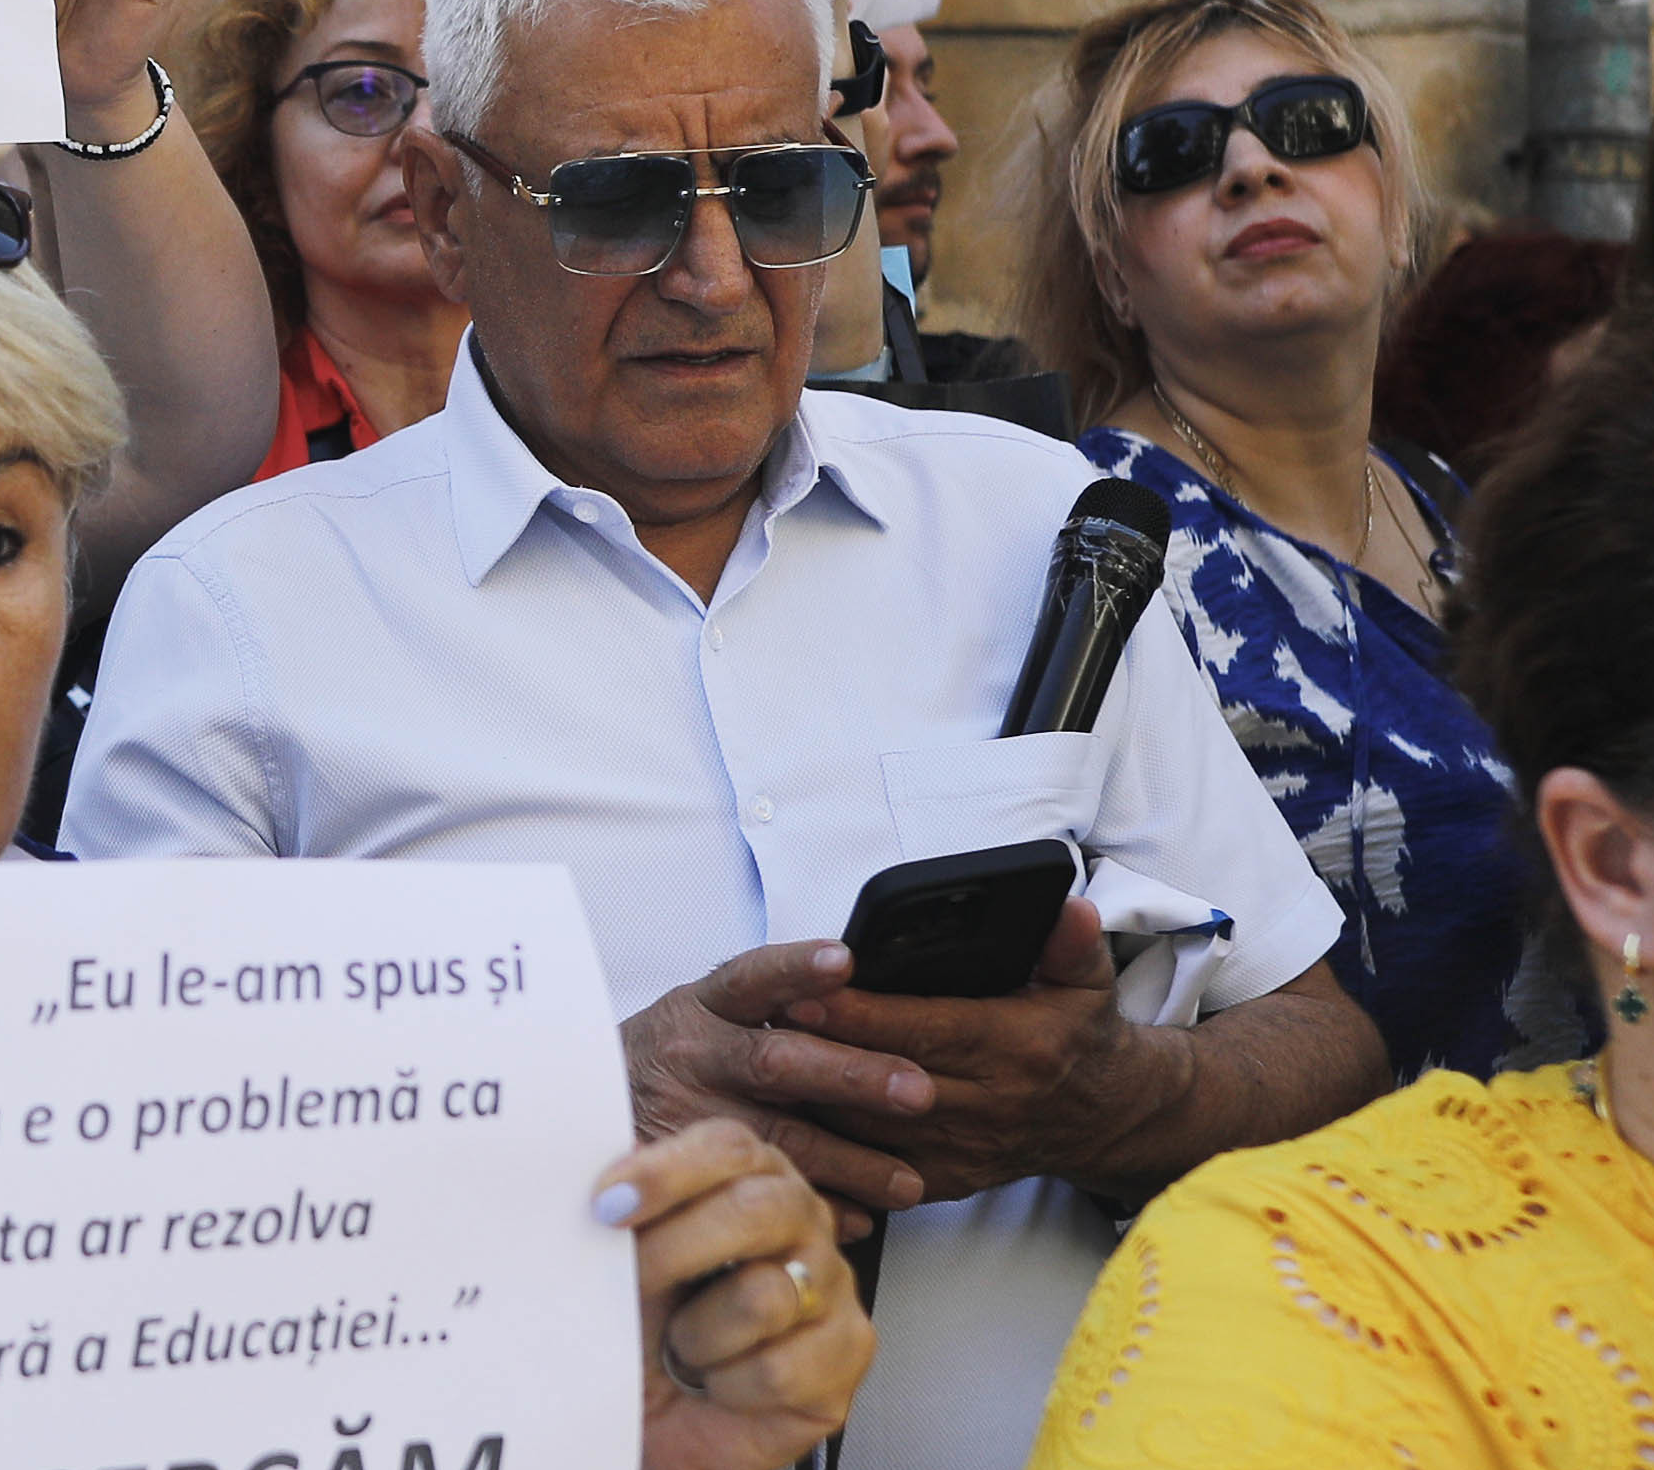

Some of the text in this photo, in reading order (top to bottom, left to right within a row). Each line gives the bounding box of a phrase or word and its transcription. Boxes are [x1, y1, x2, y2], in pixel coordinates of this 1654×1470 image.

[33, 958, 135, 1022] „Eu
[160, 952, 322, 1007] le-am
[345, 958, 467, 1011] spus
[487, 943, 524, 1006] și
[23, 1105, 53, 1145] e
[77, 1102, 111, 1141] o
[133, 1069, 419, 1152] problemă
[443, 1080, 501, 1119] ca
[79, 1217, 142, 1258] ar
[162, 1189, 372, 1251] rezolva
[74, 1335, 107, 1374] a
